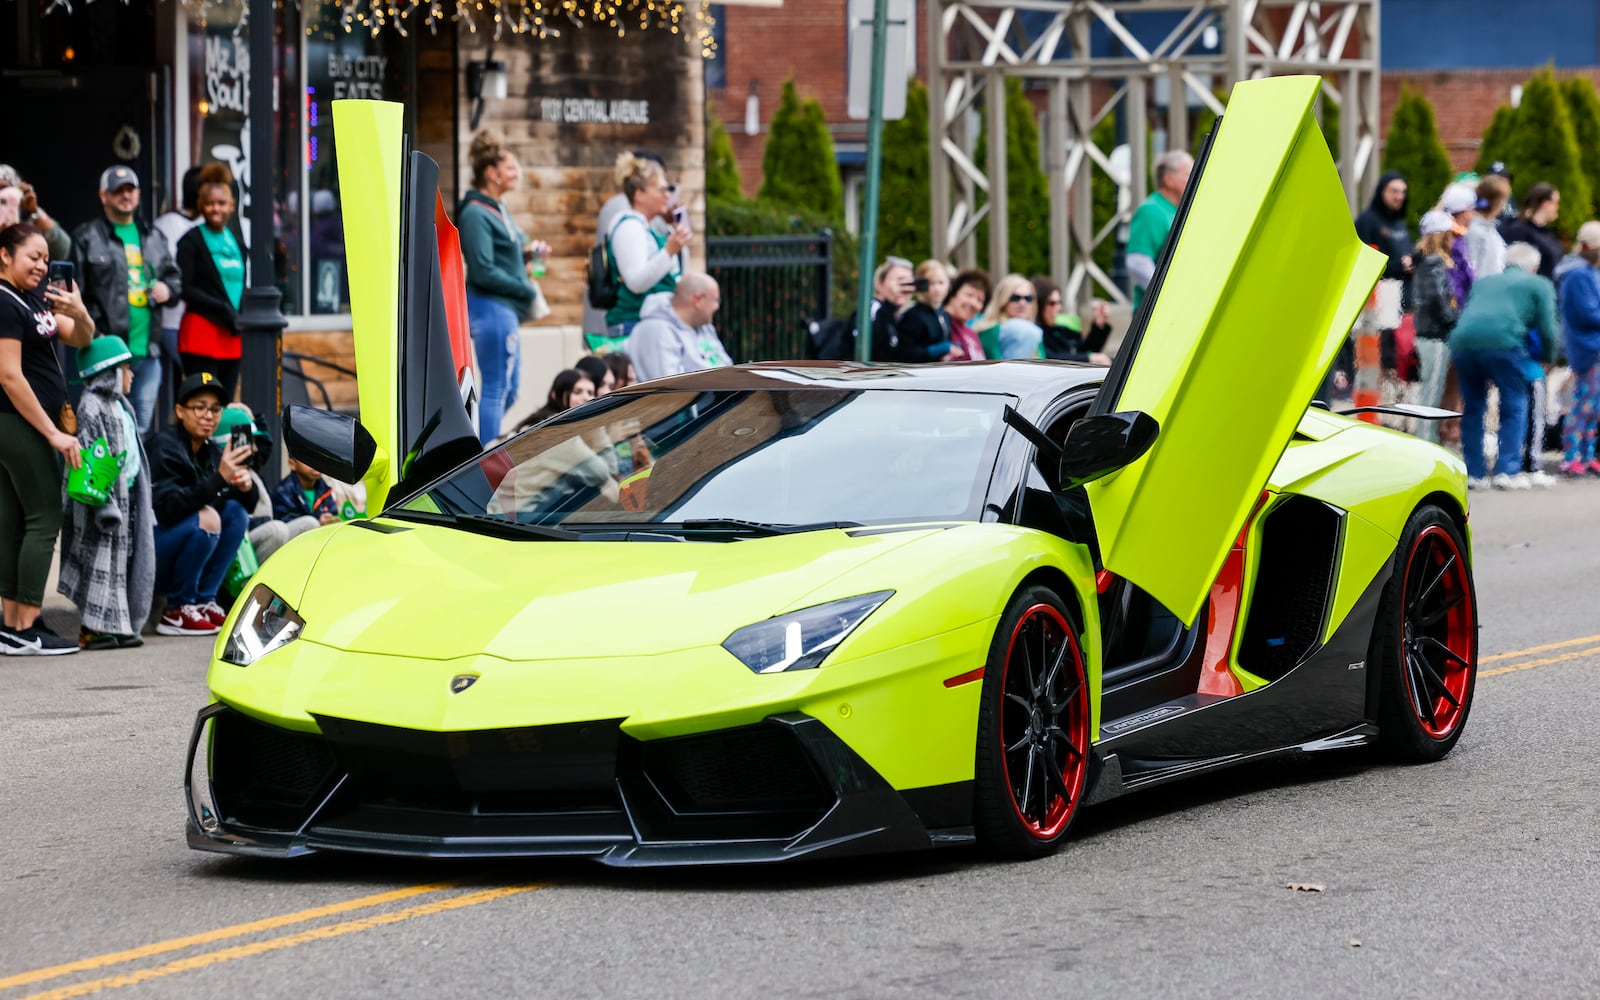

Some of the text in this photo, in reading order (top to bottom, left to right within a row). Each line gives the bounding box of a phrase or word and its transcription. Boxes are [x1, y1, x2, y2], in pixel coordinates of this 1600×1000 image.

[328, 54, 388, 80] BIG CITY
[334, 81, 383, 99] EATS
[563, 98, 608, 123] CENTRAL
[609, 99, 648, 124] AVENUE
[202, 372, 213, 385] P
